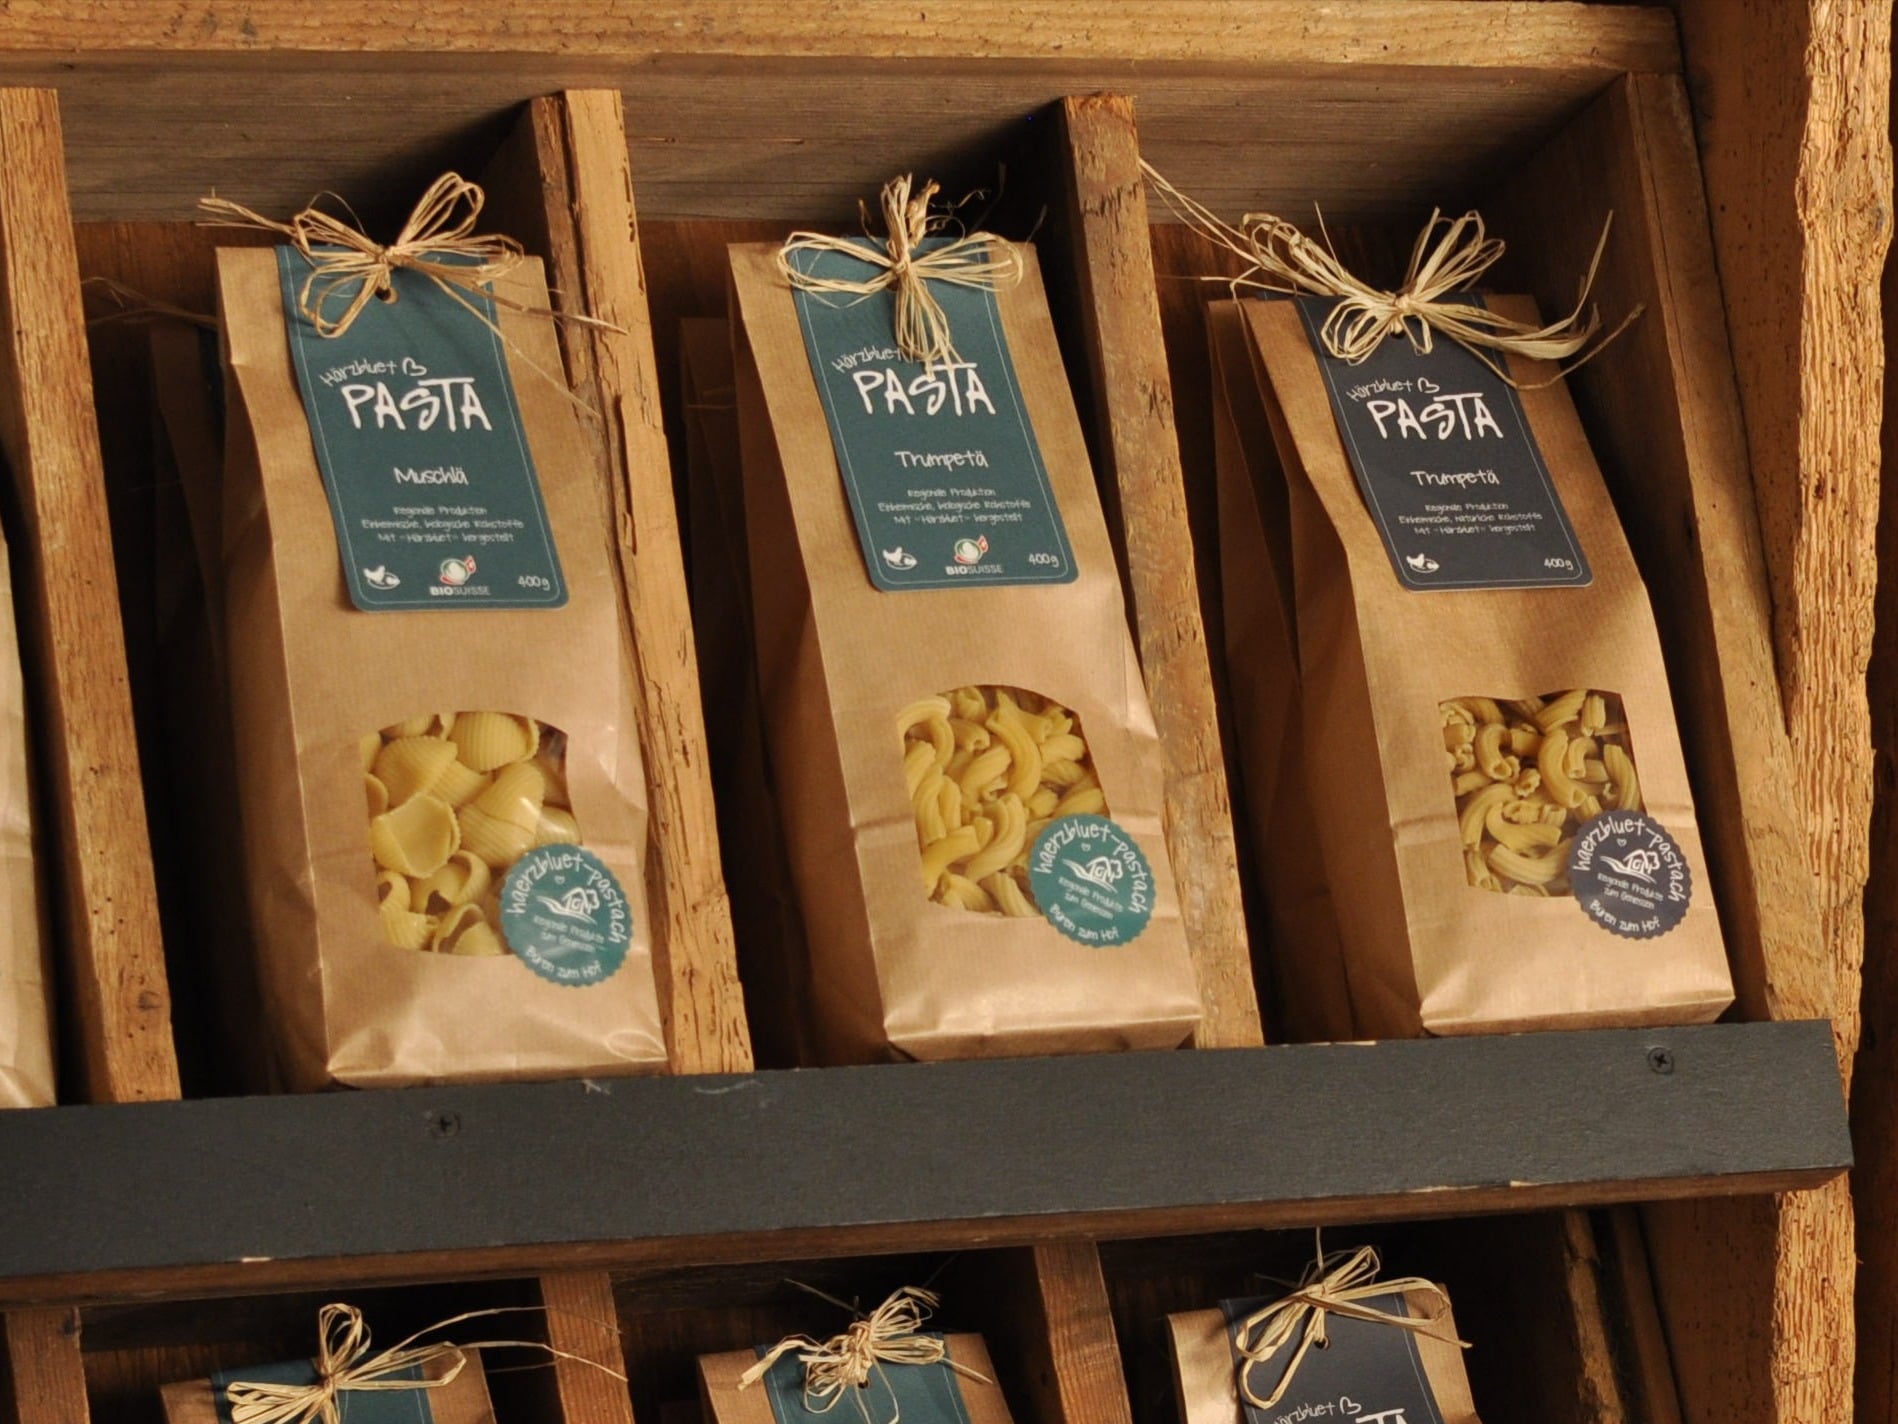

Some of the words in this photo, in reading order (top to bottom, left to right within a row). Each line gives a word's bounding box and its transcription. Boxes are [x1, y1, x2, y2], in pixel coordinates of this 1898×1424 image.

[320, 359, 397, 387] Härzbluet
[853, 363, 996, 416] PASTA
[1346, 378, 1413, 401] Härzbluet
[341, 378, 492, 431] PASTA
[1366, 393, 1503, 440] PASTA
[894, 451, 989, 471] Trumpetä
[394, 466, 468, 485] Muschlä
[1410, 469, 1500, 488] Trumpetä
[1028, 553, 1059, 567] 400g
[945, 565, 1004, 575] BIOSUISSE
[430, 586, 490, 596] BIOSUISSE
[518, 576, 550, 590] 400g
